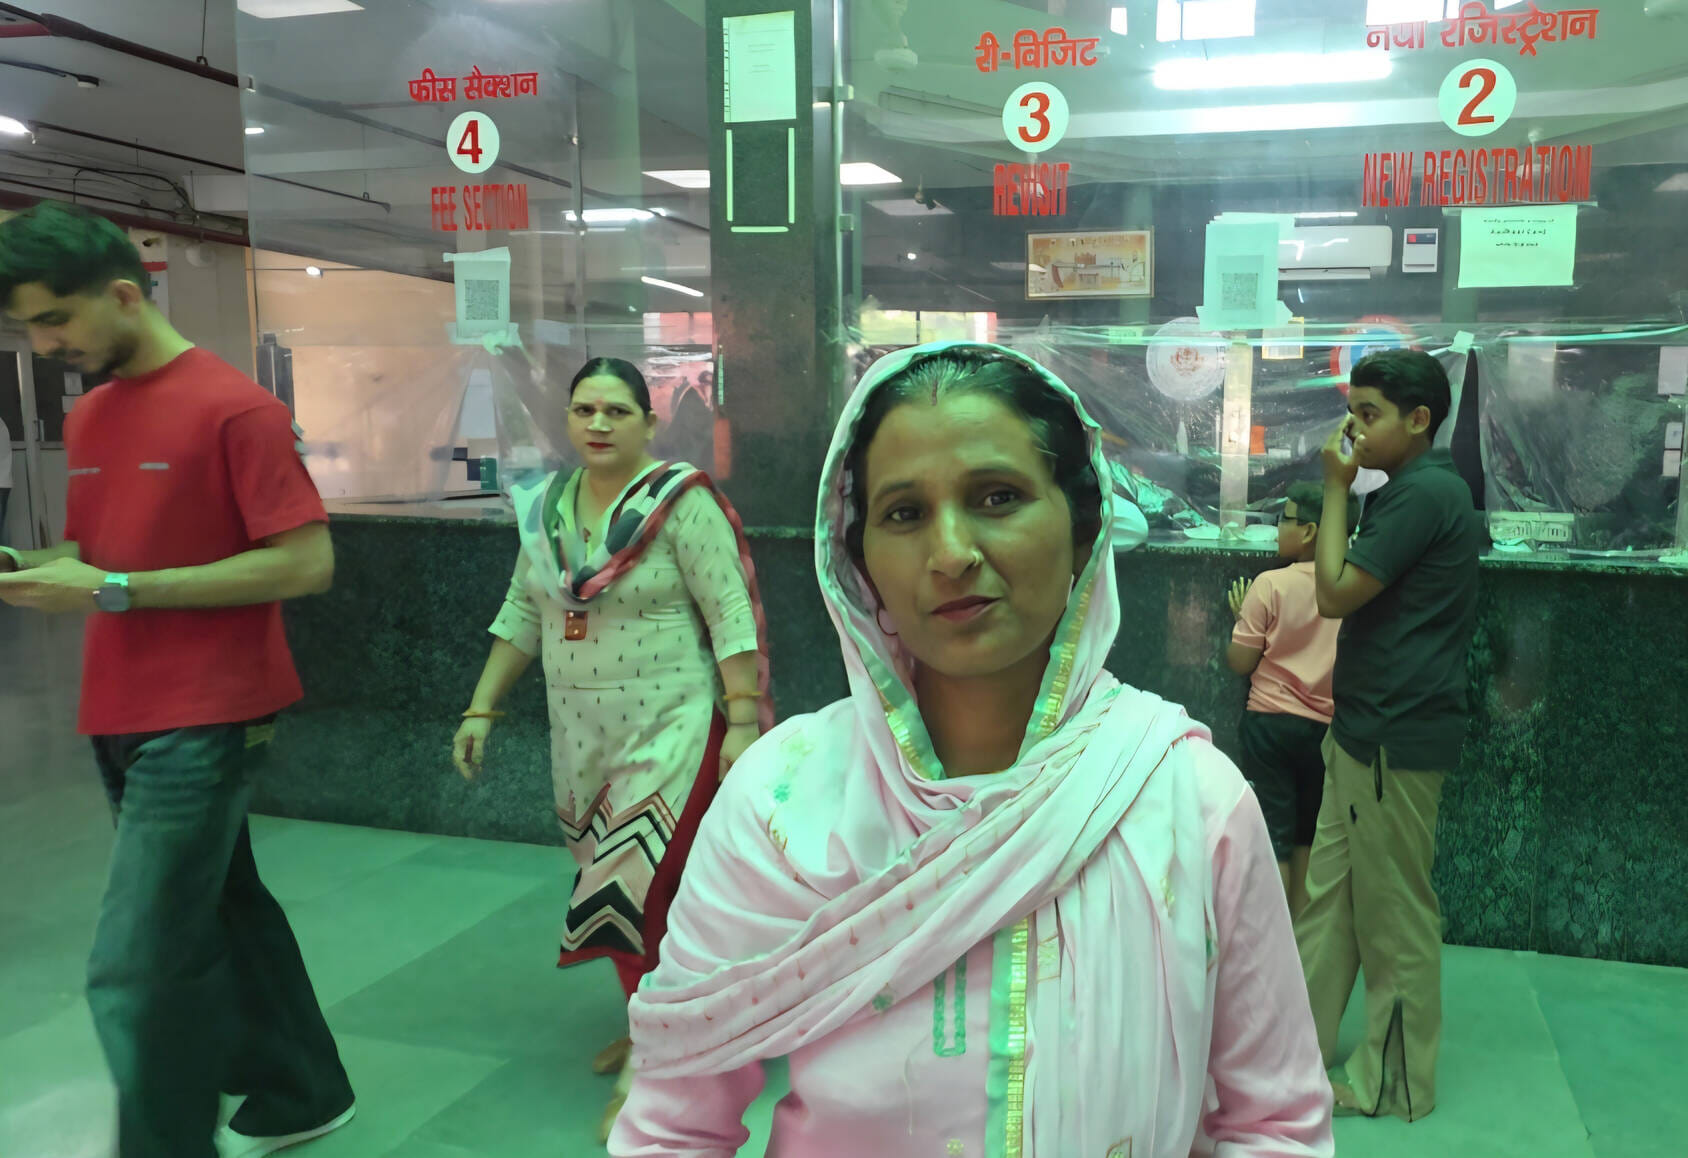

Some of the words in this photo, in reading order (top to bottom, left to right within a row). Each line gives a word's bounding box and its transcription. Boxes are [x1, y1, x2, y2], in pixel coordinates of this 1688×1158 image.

[1366, 20, 1428, 50] नया
[1440, 1, 1599, 56] रजिस्ट्रेशन
[408, 68, 457, 103] फीस
[463, 65, 538, 100] सेक्शन
[1457, 68, 1497, 125] 2
[456, 119, 483, 164] 4
[1018, 92, 1050, 143] 3
[993, 162, 1070, 216] REVISIT
[1362, 152, 1413, 207] NEW
[1420, 145, 1593, 205] REGISTRATION
[431, 186, 457, 231] FEE
[463, 184, 529, 230] SECTION
